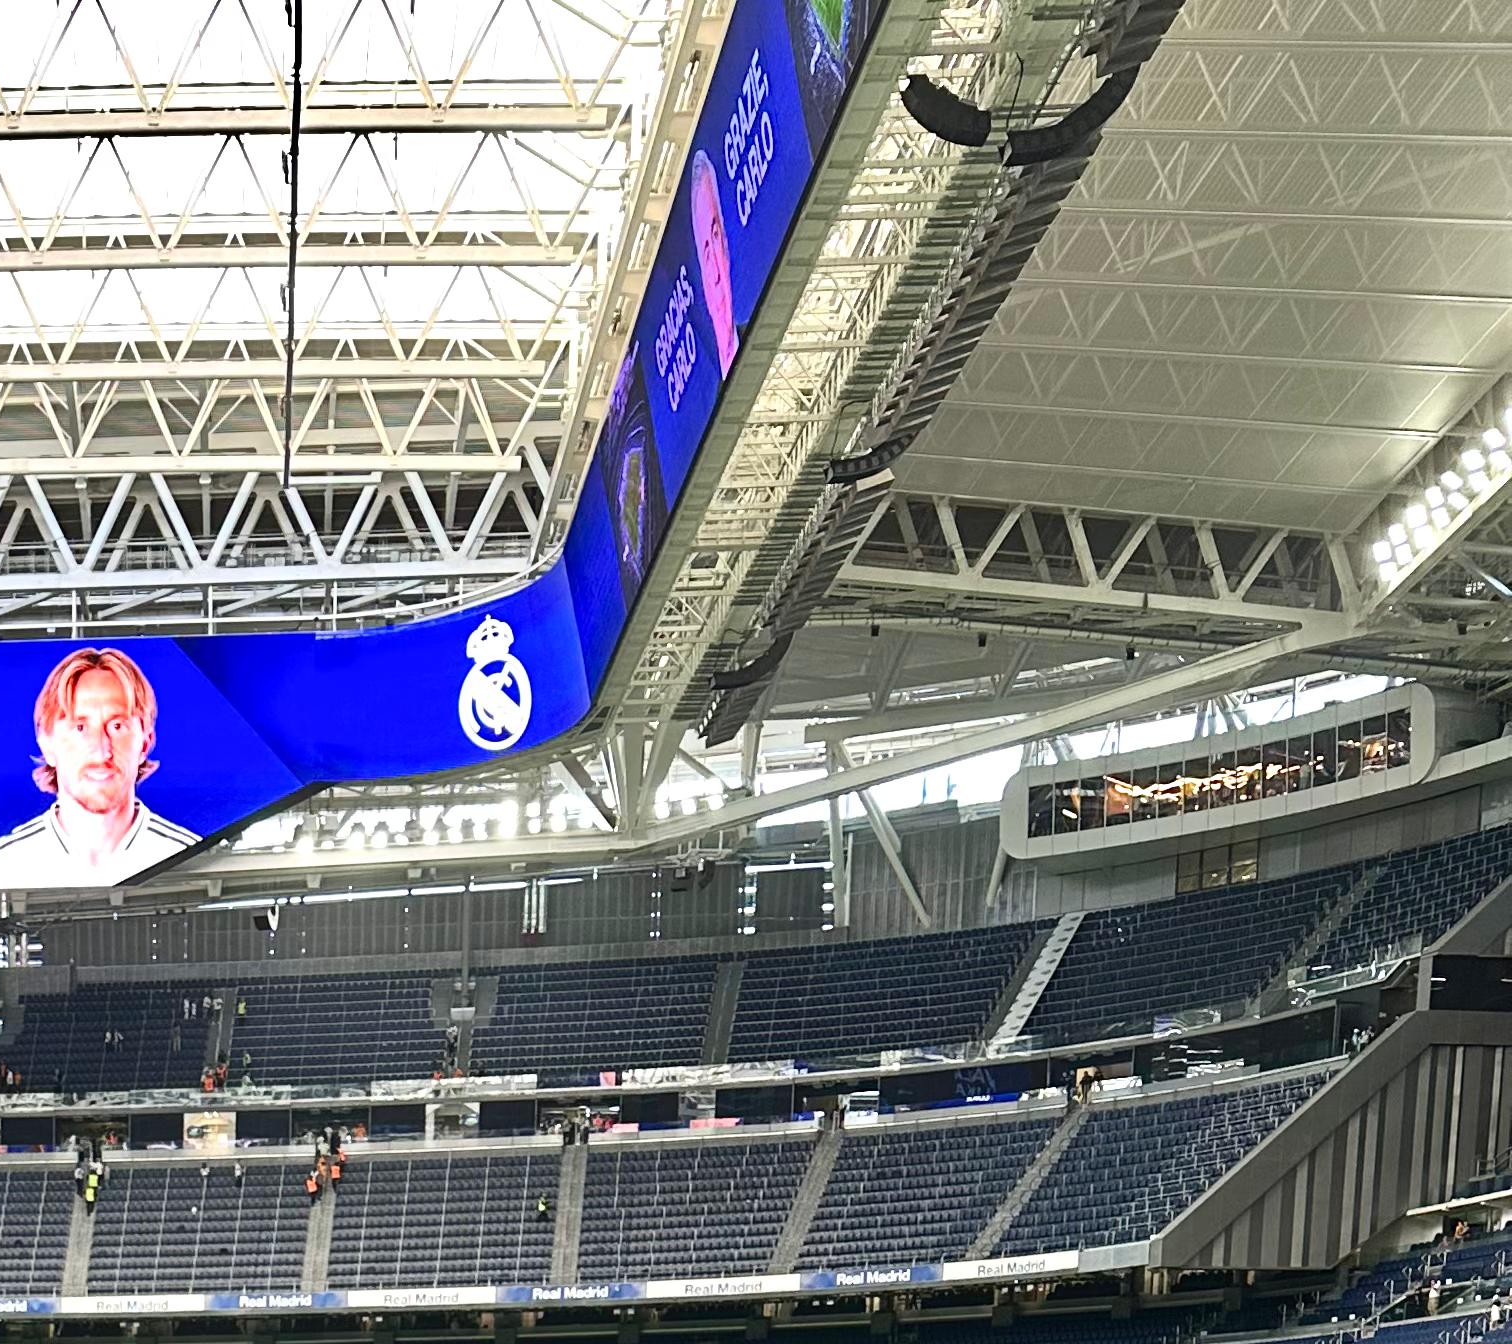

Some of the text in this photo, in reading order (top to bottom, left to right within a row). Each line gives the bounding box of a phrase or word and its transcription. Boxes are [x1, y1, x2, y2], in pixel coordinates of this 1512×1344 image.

[724, 48, 769, 180] GRAZIE,
[736, 112, 774, 227] CARLO
[656, 265, 694, 377] GRACIAS,
[667, 322, 697, 412] CARLO
[239, 1294, 312, 1308] Real Madrid
[532, 1286, 609, 1300] Real Madrid
[836, 1269, 911, 1286] Real Madrid
